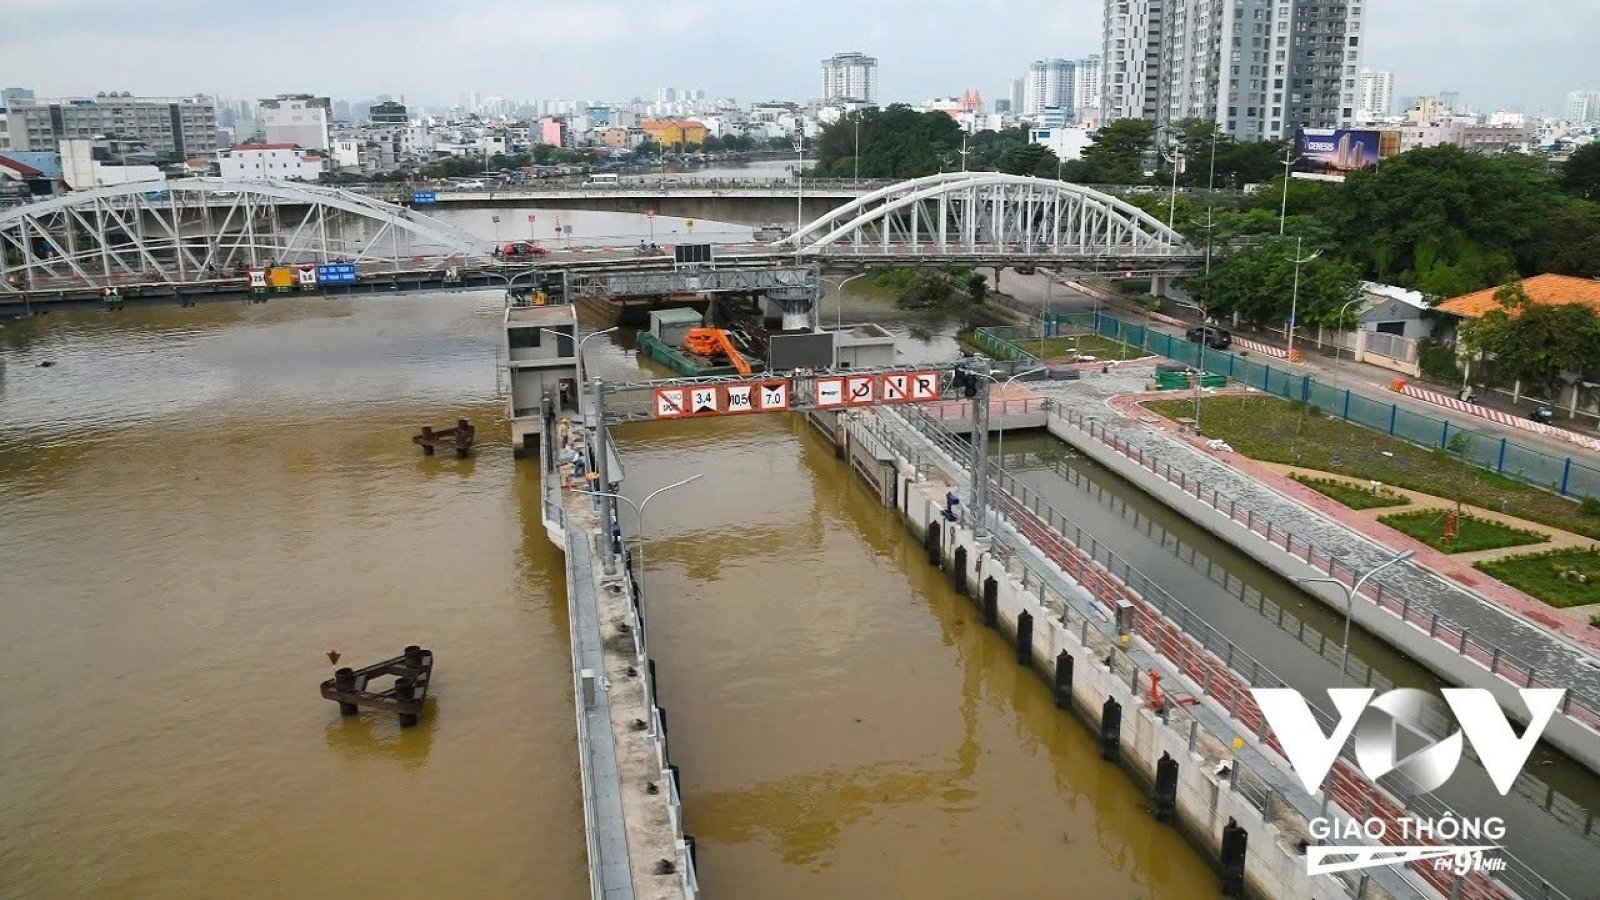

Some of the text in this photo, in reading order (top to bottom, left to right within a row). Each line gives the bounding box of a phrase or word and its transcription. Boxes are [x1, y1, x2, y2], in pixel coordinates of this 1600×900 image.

[919, 379, 930, 393] P
[696, 392, 712, 404] 3.4
[766, 393, 781, 405] 7.0
